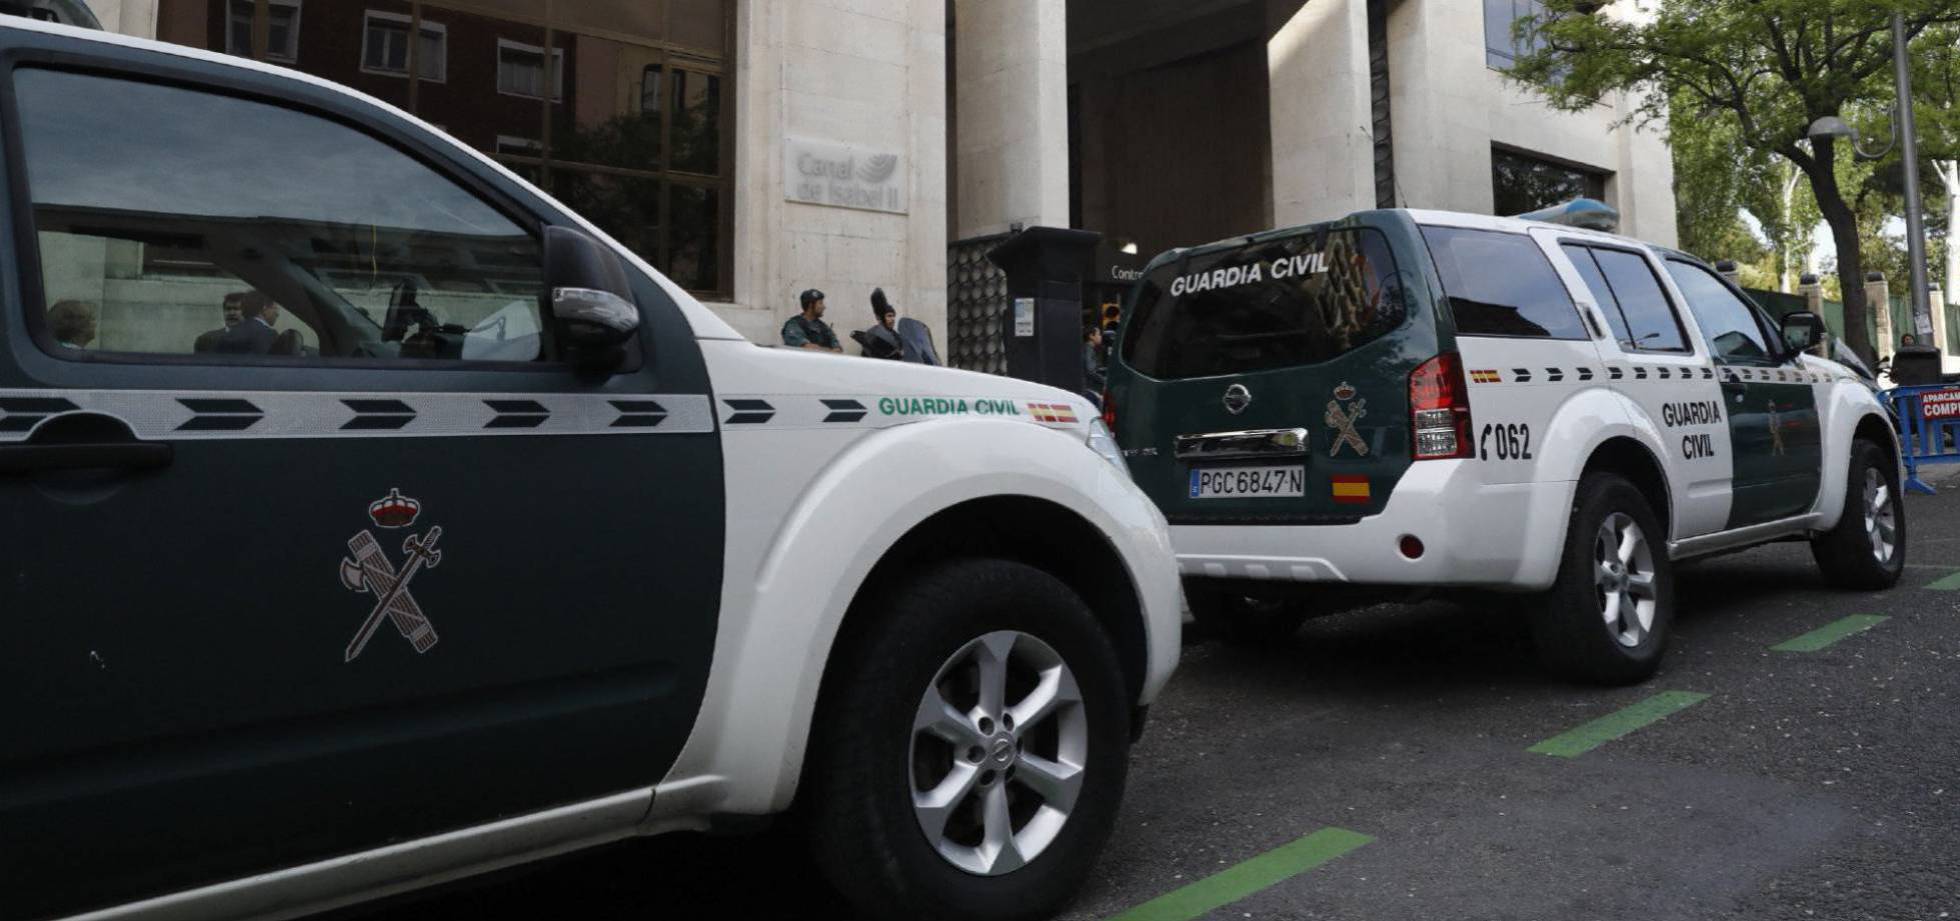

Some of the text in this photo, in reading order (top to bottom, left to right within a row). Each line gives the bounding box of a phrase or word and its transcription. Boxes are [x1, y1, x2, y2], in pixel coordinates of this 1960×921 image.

[797, 151, 853, 180] Canal
[797, 177, 822, 201] de
[1170, 252, 1329, 297] GUARDIA CIVIL
[879, 397, 1020, 416] GUARDIA CIVIL
[1662, 400, 1722, 427] GUARDIA
[1923, 402, 1960, 417] COMP
[1494, 423, 1532, 460] 062
[1682, 434, 1715, 460] CIVIL
